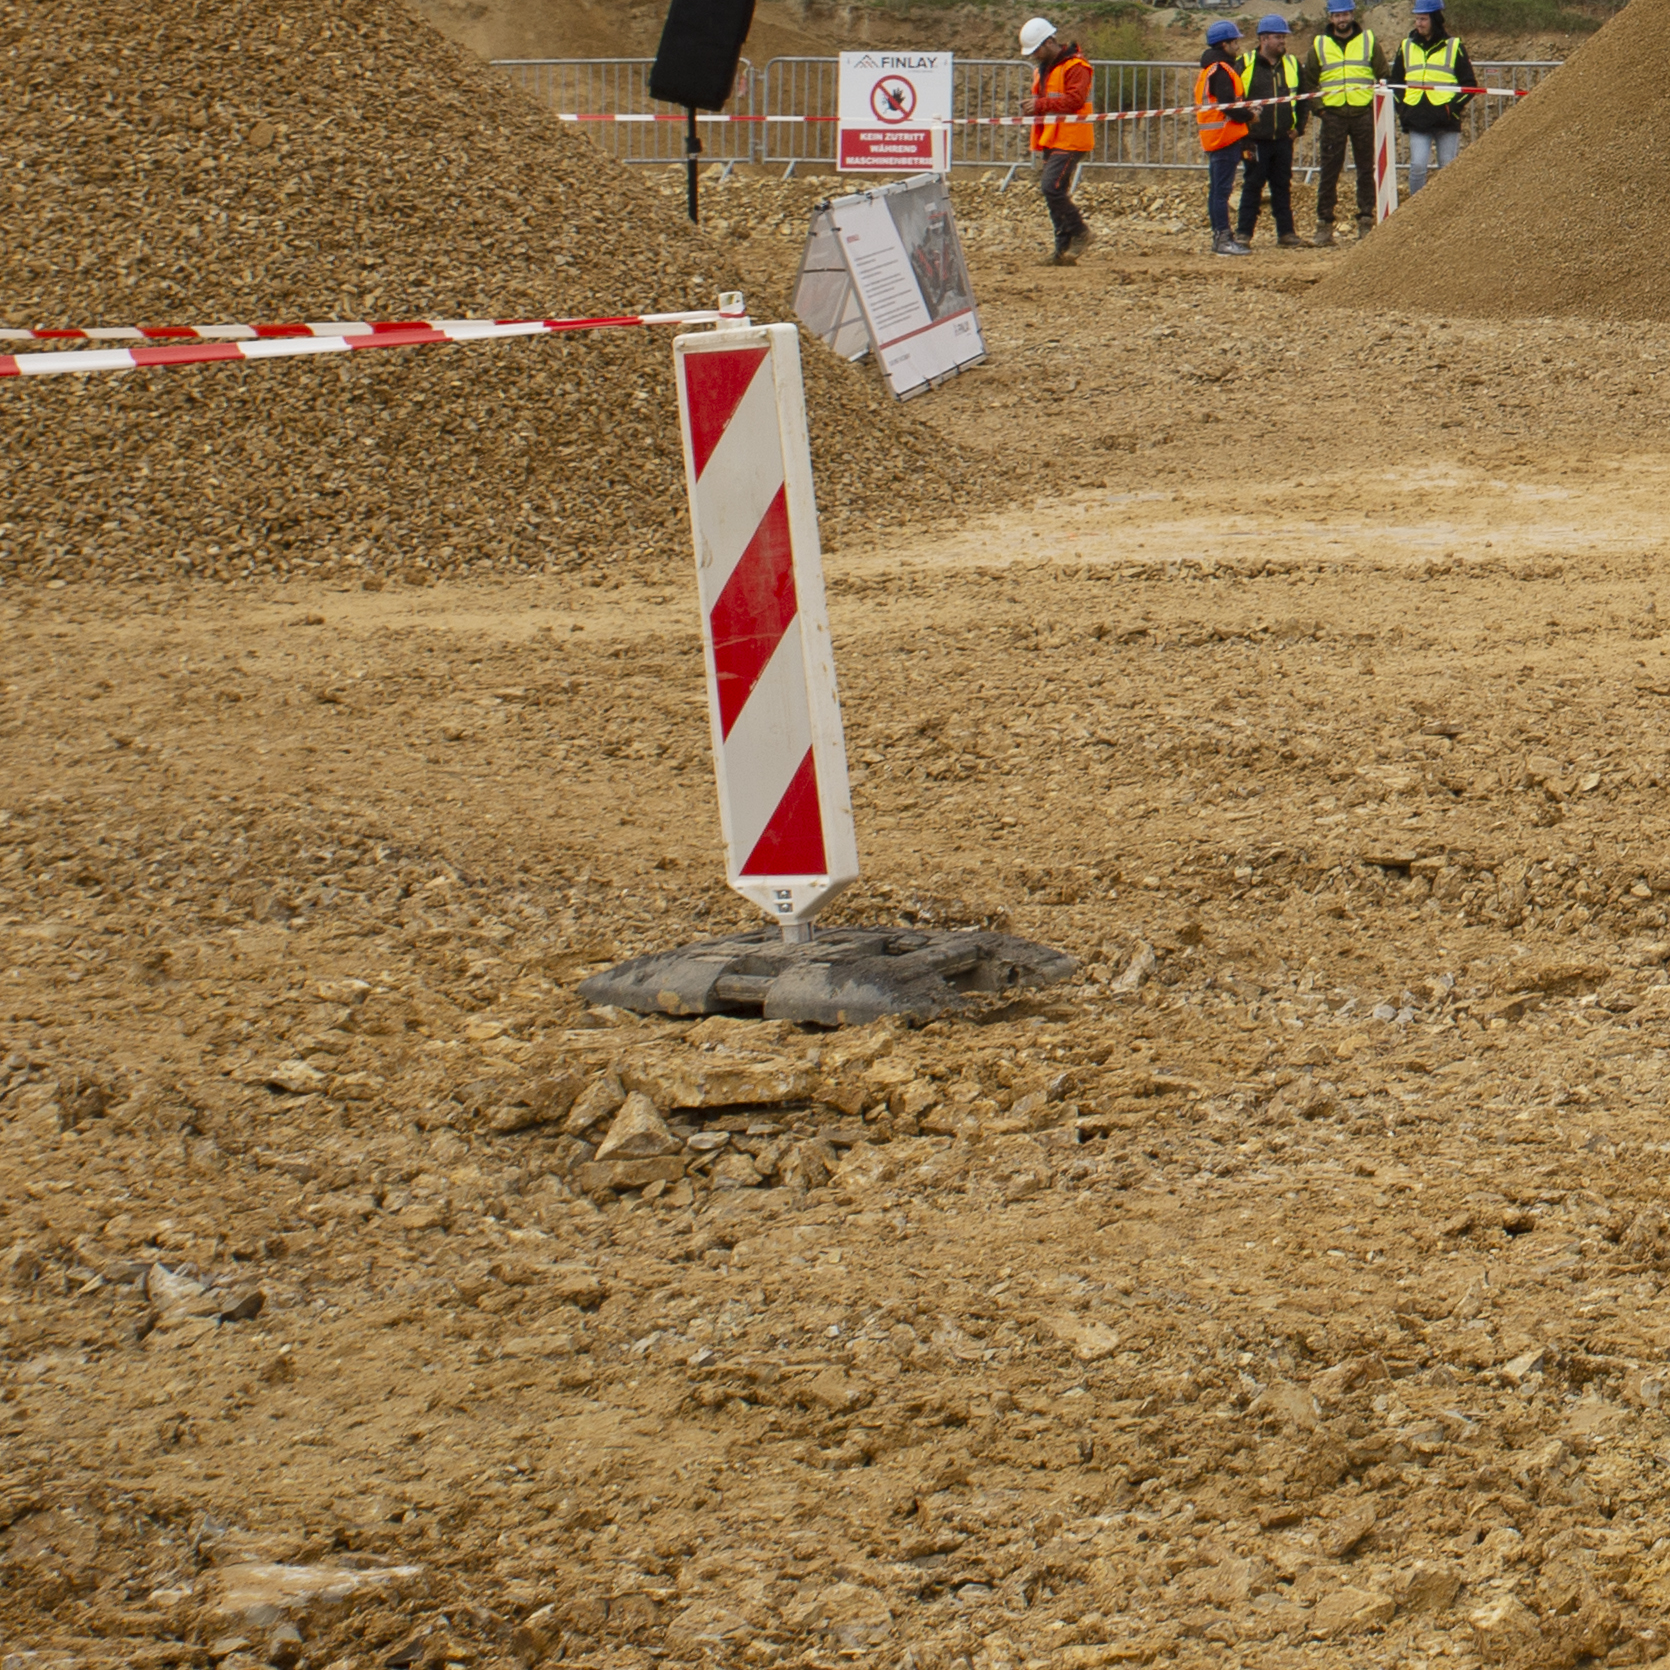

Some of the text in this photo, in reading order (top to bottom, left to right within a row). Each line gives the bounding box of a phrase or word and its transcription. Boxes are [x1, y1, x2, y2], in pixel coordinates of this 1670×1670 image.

[881, 56, 938, 69] FINLAY
[859, 132, 926, 141] KEIN ZUTRITT
[869, 143, 918, 153] WÄHREND
